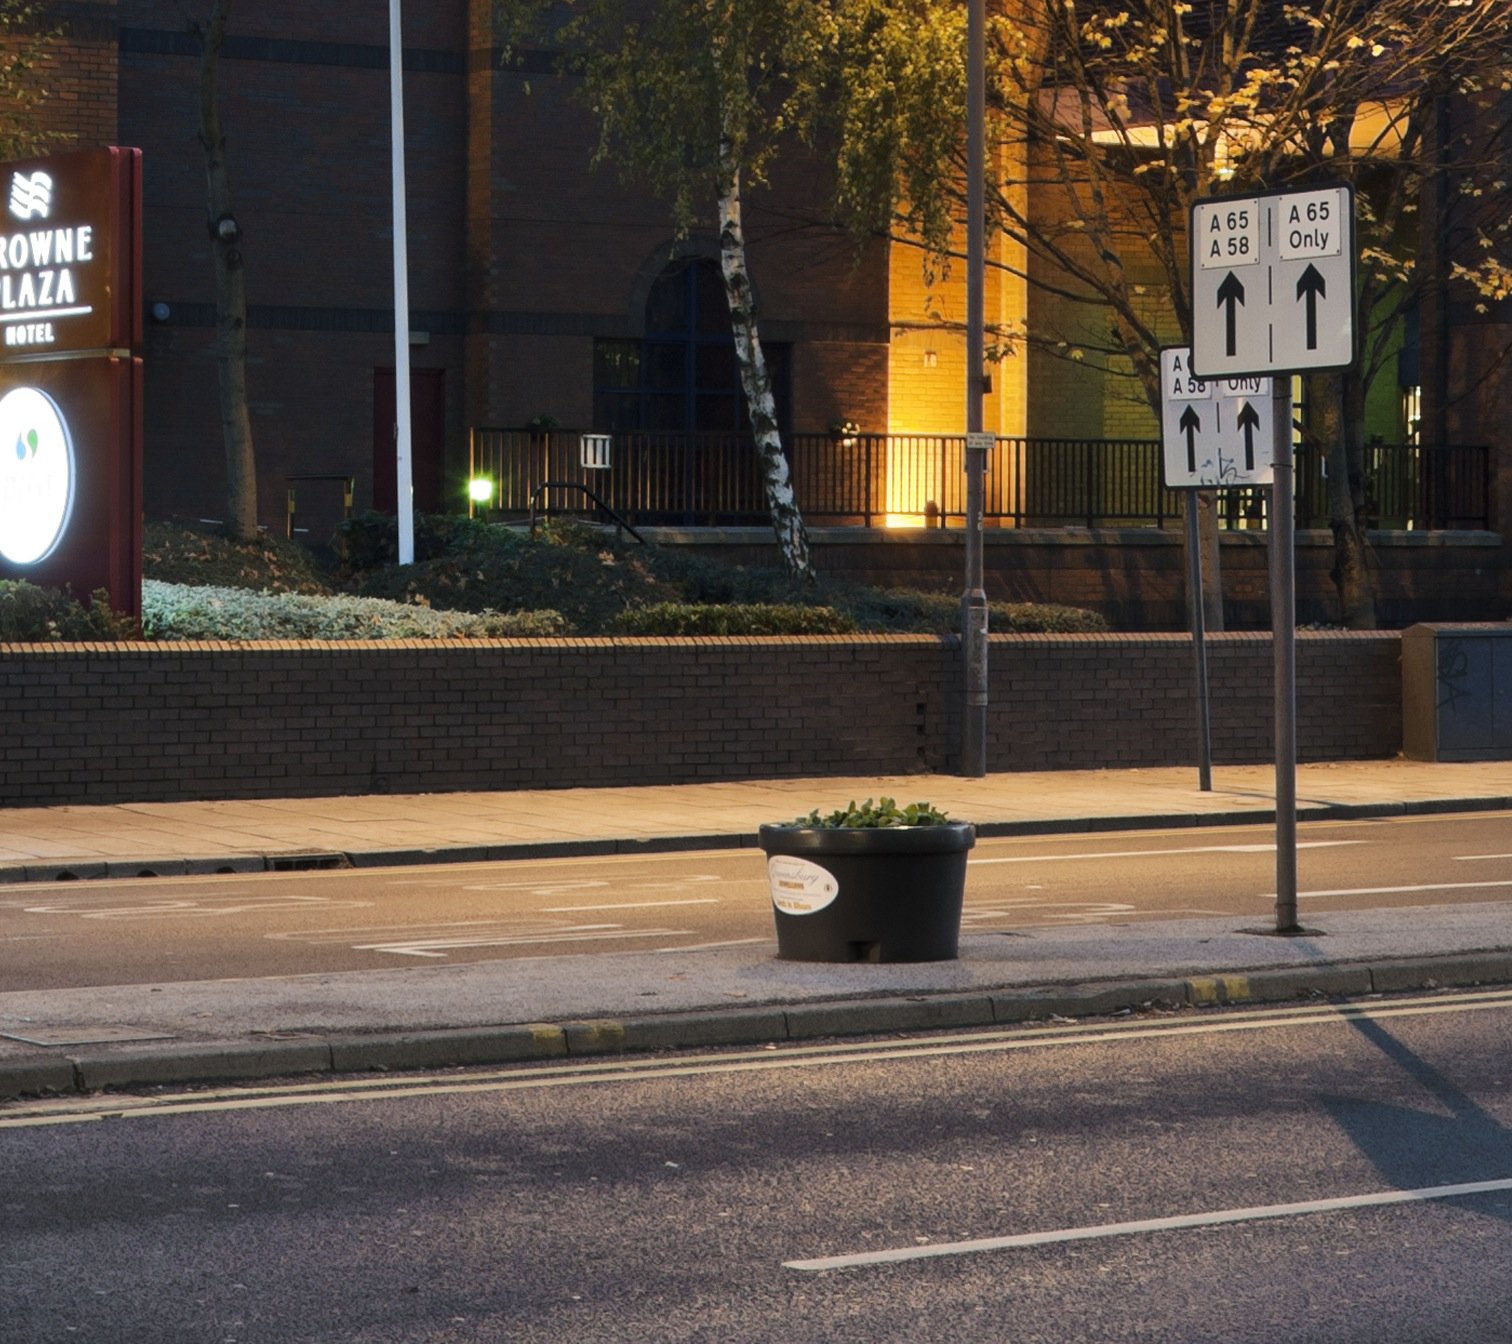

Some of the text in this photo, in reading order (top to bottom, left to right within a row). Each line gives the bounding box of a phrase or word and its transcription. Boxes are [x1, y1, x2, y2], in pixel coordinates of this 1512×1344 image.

[1210, 211, 1249, 232] A 65
[1289, 201, 1330, 224] A 65
[1210, 236, 1249, 258] A 58
[1289, 228, 1329, 250] Only
[5, 322, 55, 345] HOTEL
[1173, 355, 1182, 372] A
[1173, 376, 1206, 395] A 58
[1228, 377, 1261, 393] Only
